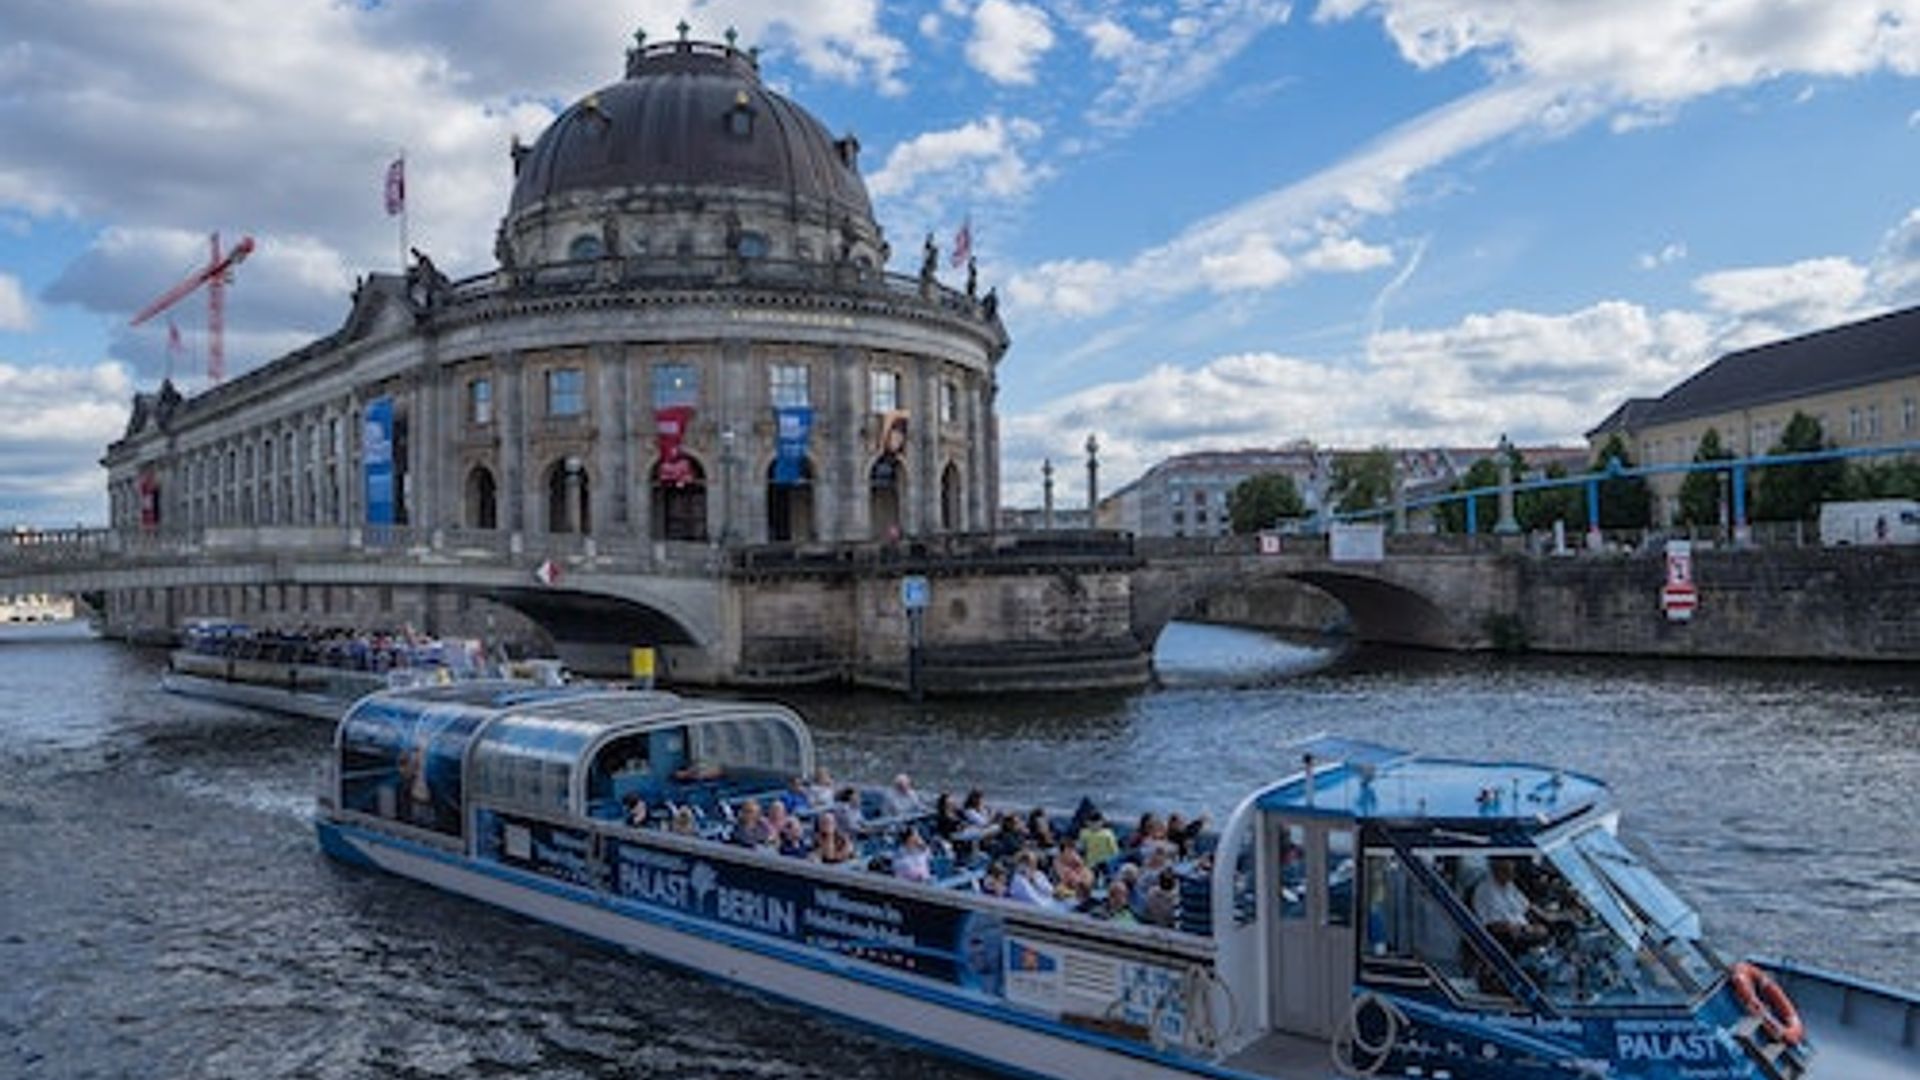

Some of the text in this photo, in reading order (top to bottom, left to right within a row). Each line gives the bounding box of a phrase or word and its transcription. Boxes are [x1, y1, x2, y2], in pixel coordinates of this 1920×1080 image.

[618, 861, 690, 909] PALAST
[717, 885, 797, 936] BERLIN
[1616, 1033, 1720, 1061] PALAST
